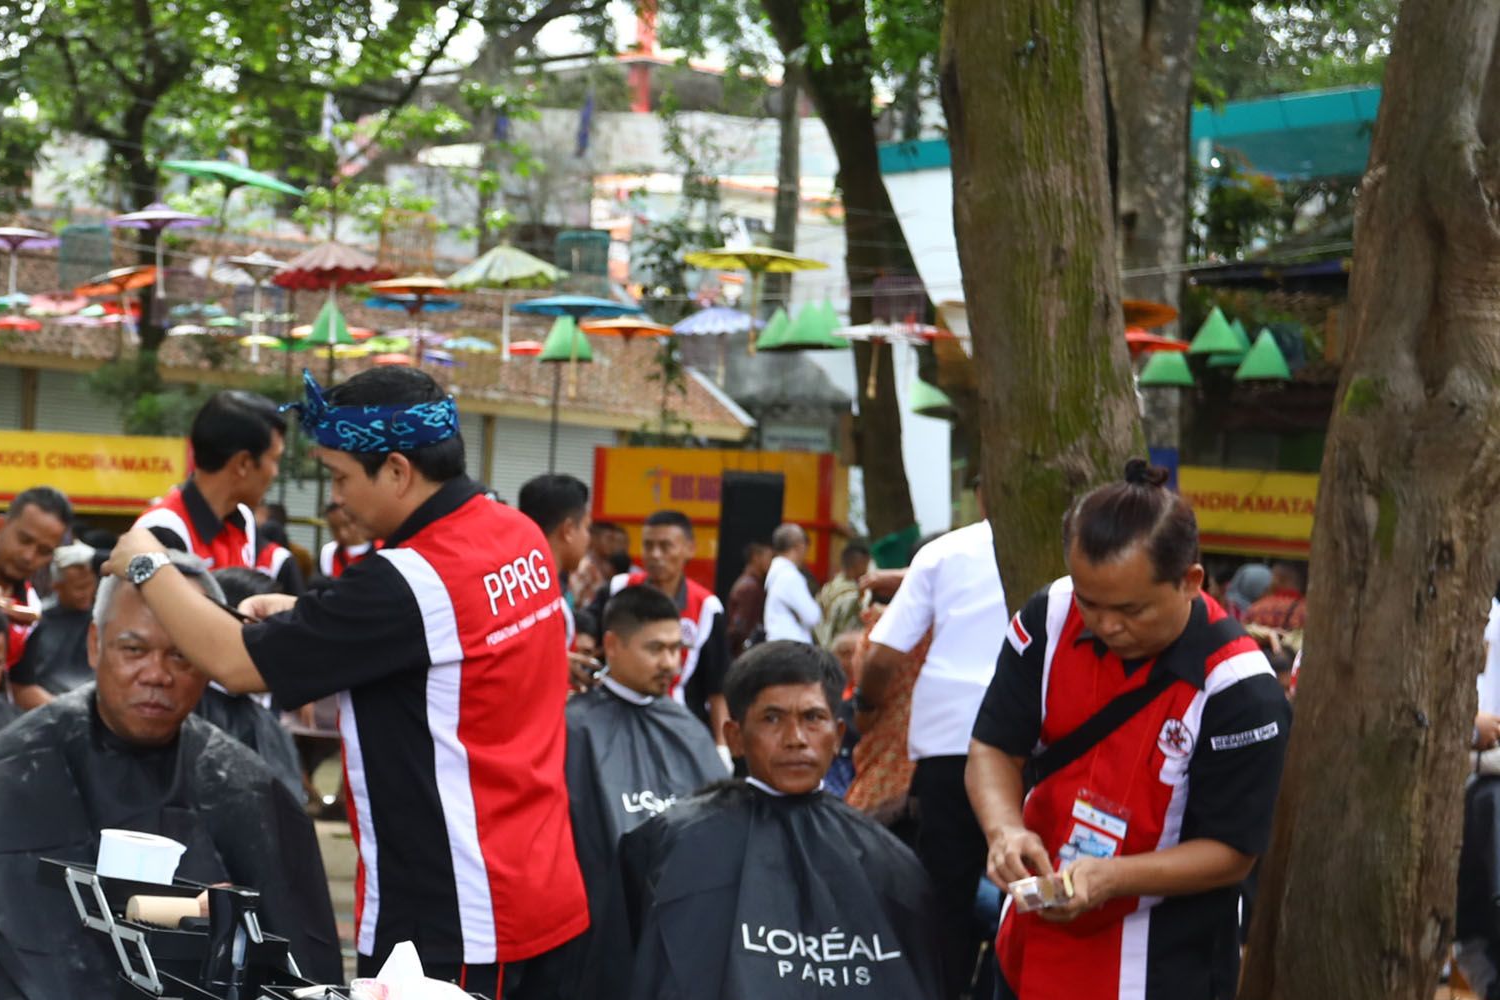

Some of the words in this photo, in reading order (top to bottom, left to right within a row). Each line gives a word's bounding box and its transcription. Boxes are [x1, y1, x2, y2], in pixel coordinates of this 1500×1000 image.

[45, 452, 173, 473] CINDRAMATA
[483, 549, 550, 616] PPRG
[742, 923, 901, 962] L'ORÉAL
[778, 960, 871, 987] PARIS
